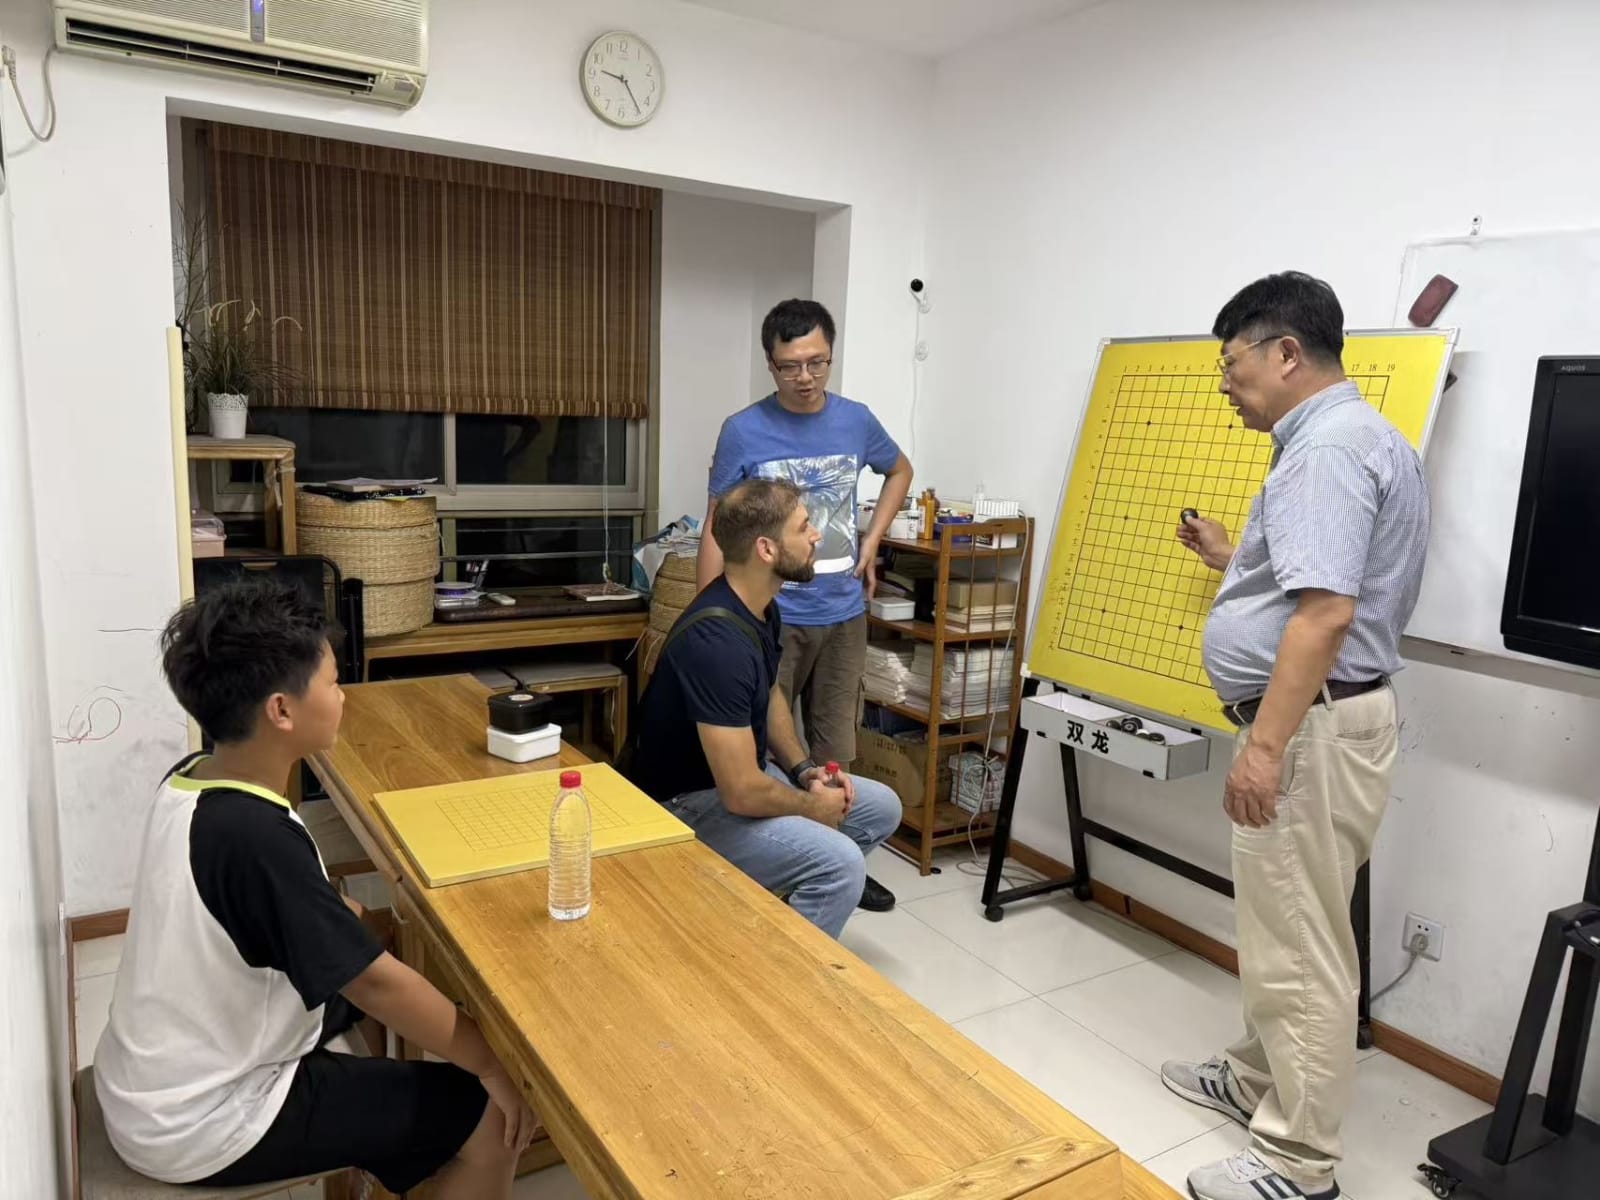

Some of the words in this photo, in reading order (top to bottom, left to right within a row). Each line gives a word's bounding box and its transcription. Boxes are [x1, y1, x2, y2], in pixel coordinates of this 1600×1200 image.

[606, 42, 612, 54] 11
[618, 41, 628, 53] 12
[593, 53, 603, 64] 10
[589, 67, 596, 78] 9
[646, 64, 653, 77] 2
[593, 85, 600, 96] 8
[650, 80, 655, 92] 3
[605, 99, 611, 111] 7
[643, 96, 650, 106] 4
[618, 107, 625, 119] 6
[1352, 364, 1360, 372] 17
[1369, 364, 1377, 372] 18
[1387, 364, 1396, 372] 19
[1067, 720, 1109, 754] 双龙
